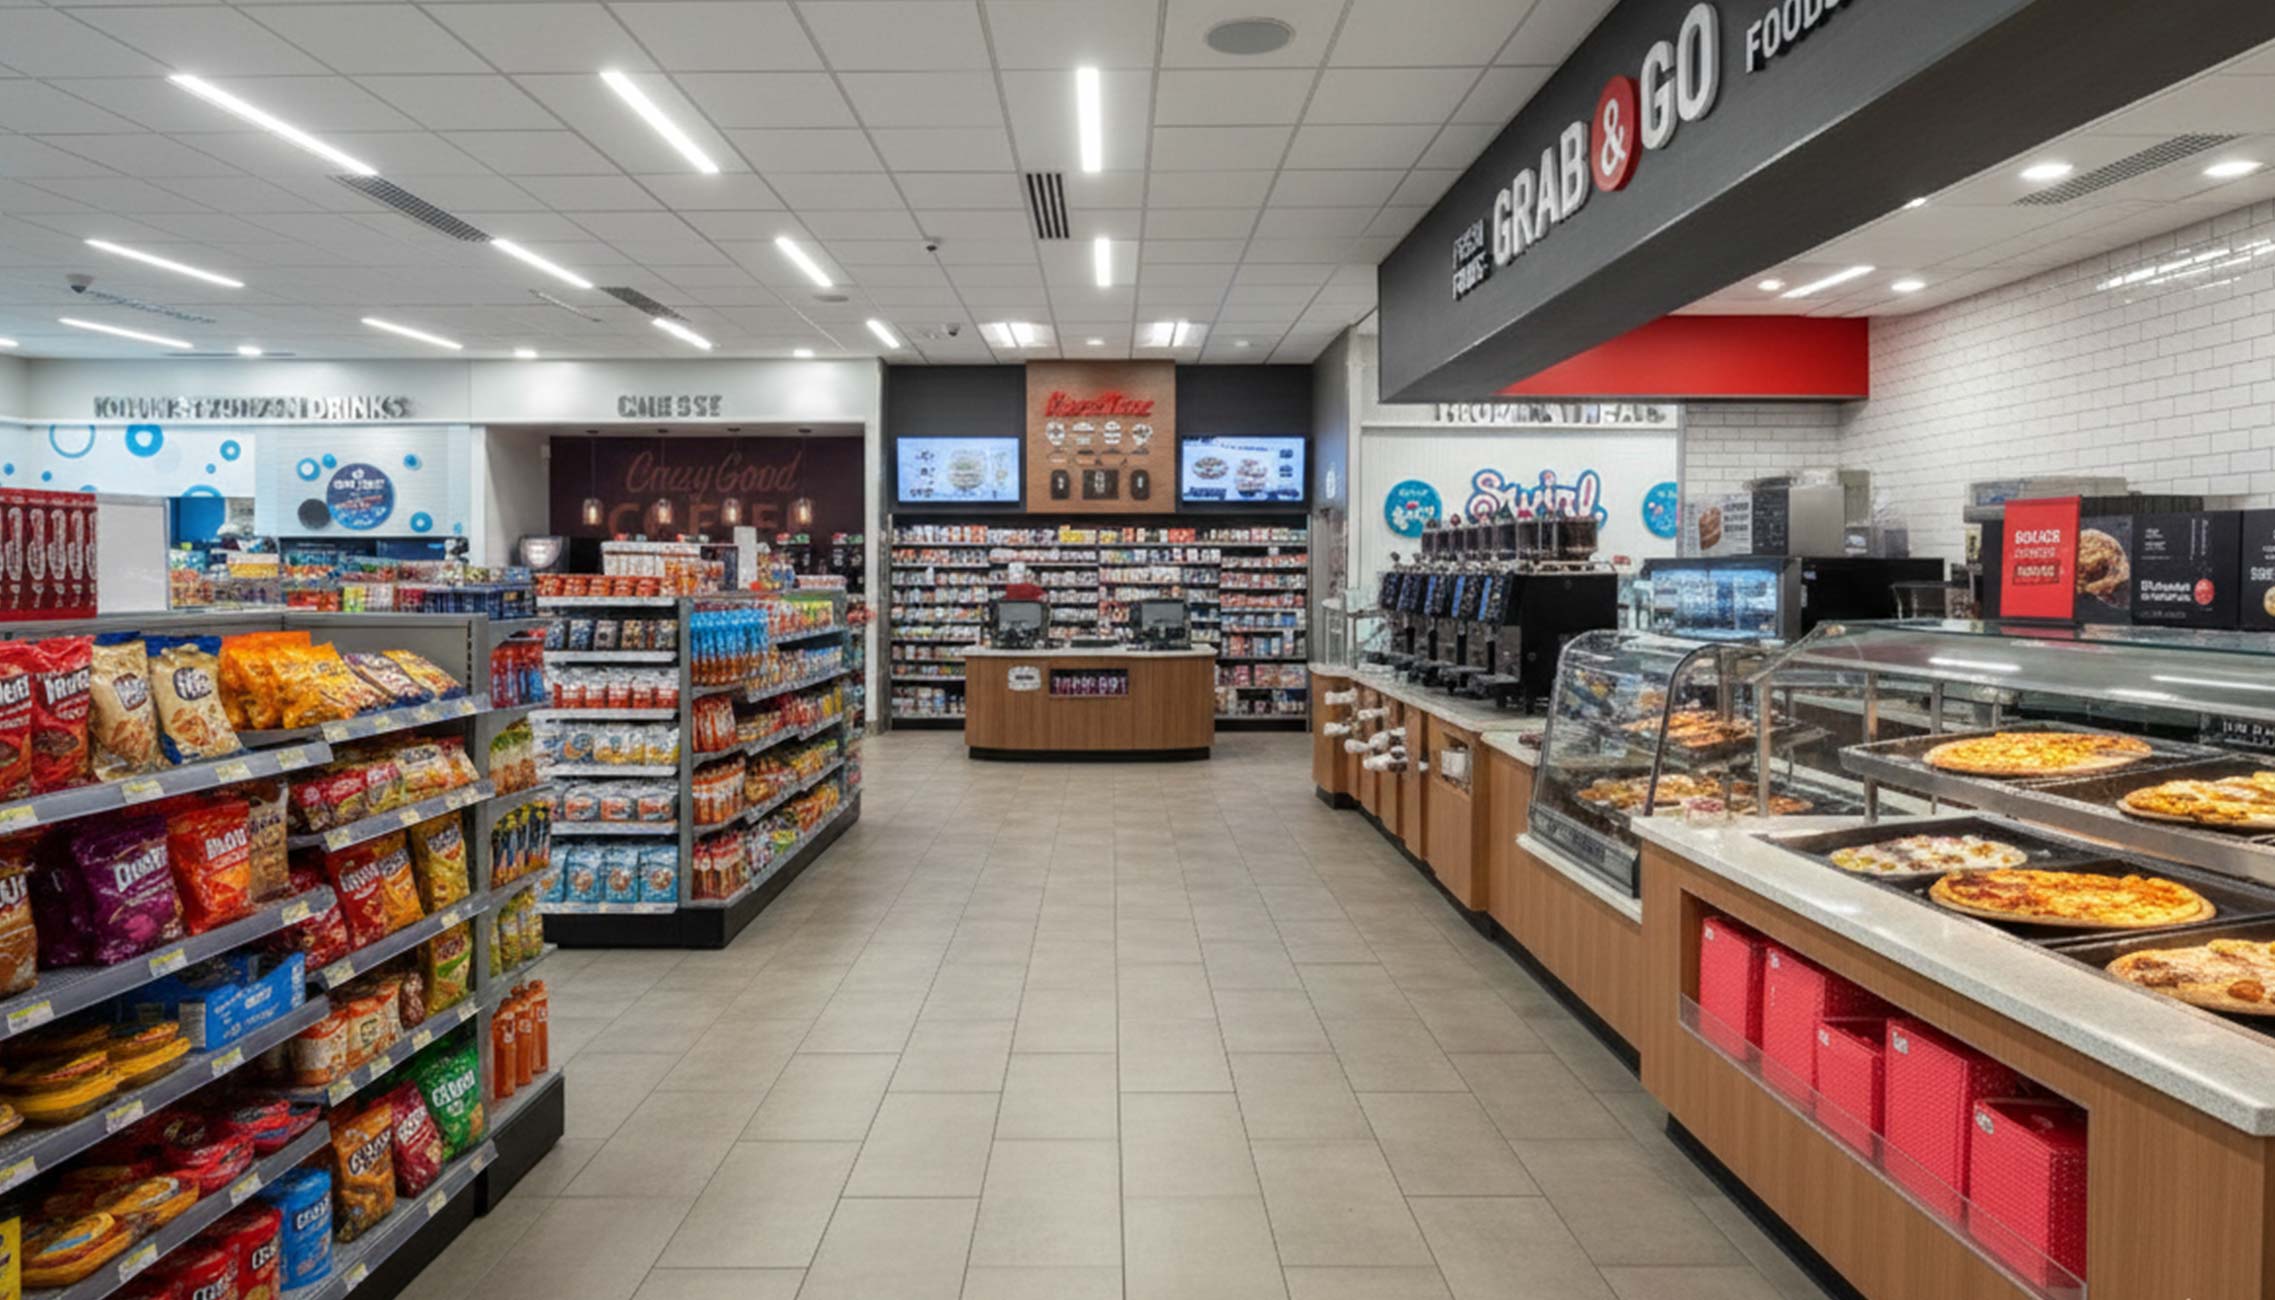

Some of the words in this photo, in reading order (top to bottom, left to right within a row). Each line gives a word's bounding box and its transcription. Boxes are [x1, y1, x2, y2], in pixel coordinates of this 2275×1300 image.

[1745, 0, 1841, 73] FOOD
[1493, 120, 1589, 266] GRAB
[1601, 98, 1627, 177] &
[1640, 2, 1720, 150] GO
[715, 449, 801, 494] Good
